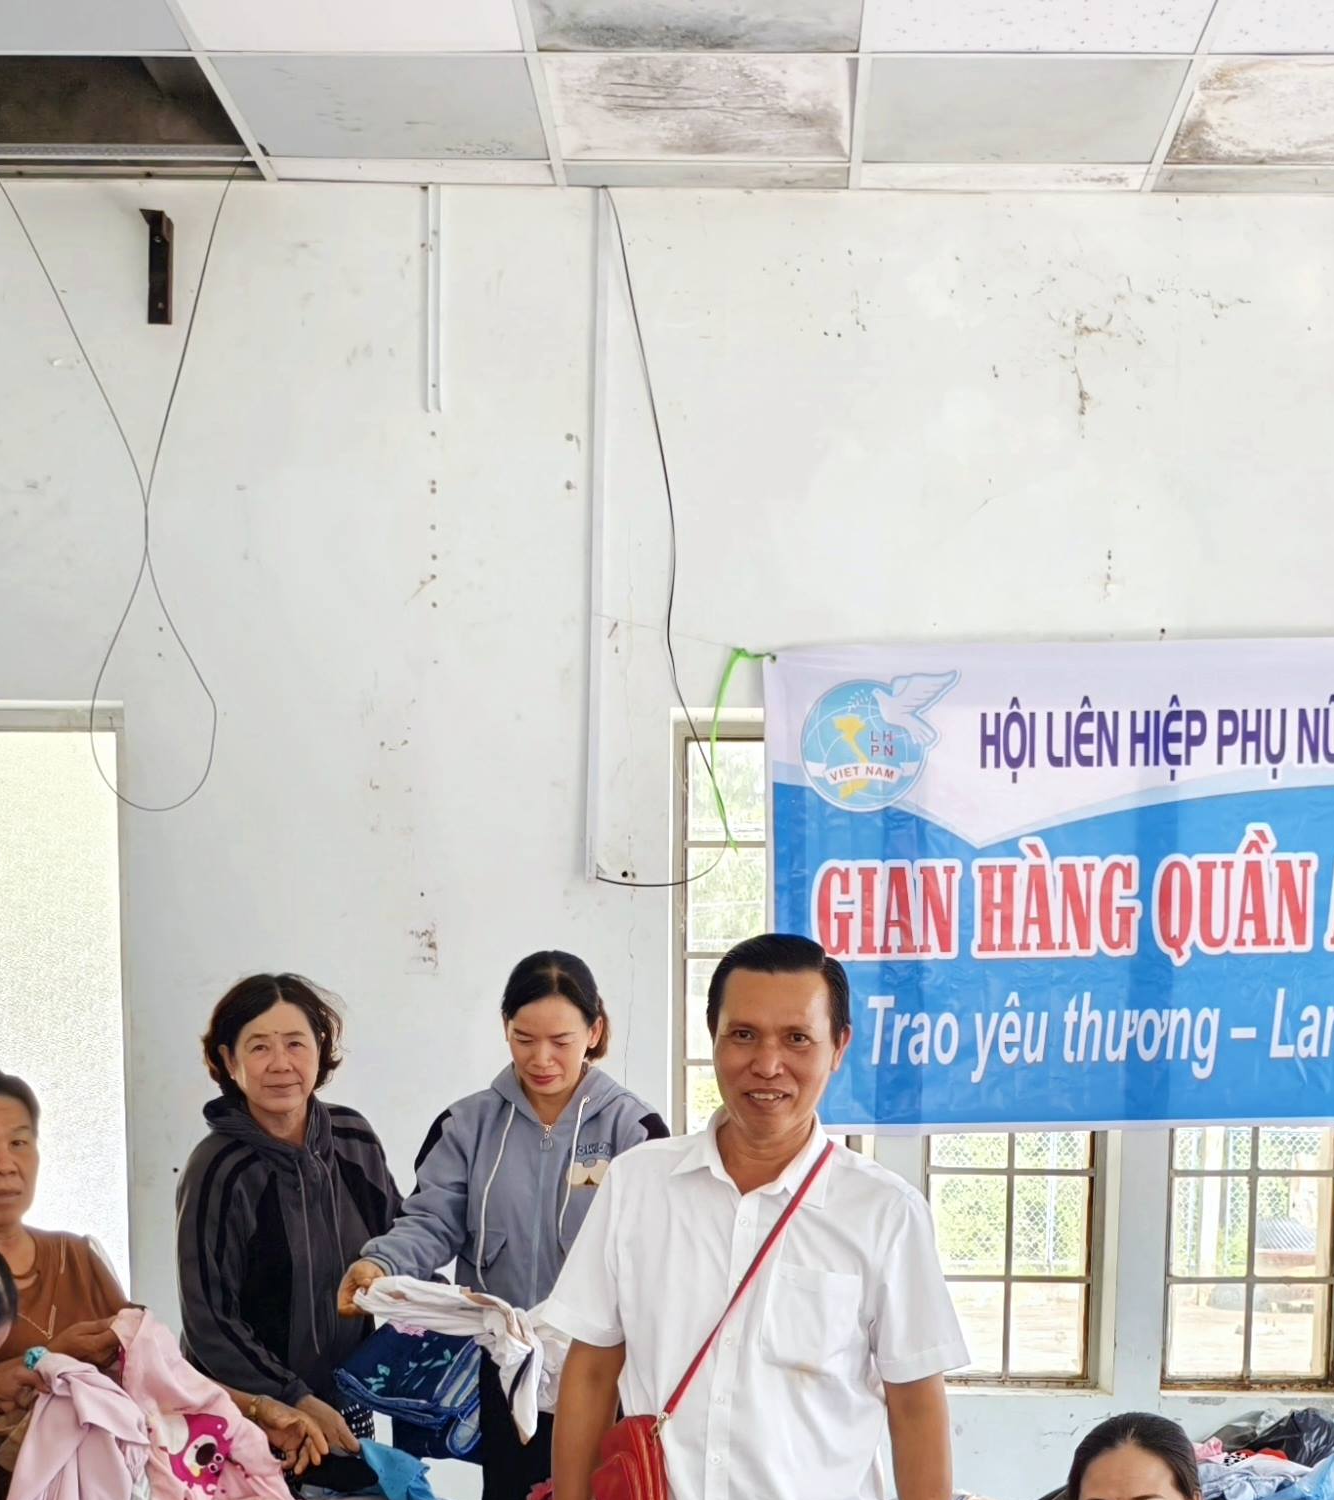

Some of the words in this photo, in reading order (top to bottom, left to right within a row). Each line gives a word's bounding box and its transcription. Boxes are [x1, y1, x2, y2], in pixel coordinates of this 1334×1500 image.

[864, 764, 896, 781] NAM
[979, 695, 1037, 785] HỘI
[1045, 694, 1120, 769] LIÊN
[1129, 693, 1209, 783] HIỆP
[1215, 707, 1289, 781] PHỤ
[814, 862, 959, 957] GIAN
[975, 842, 1138, 954] HÀNG
[1157, 828, 1314, 961] QUẦN
[866, 993, 961, 1066] Trao
[970, 990, 1051, 1084] yêu
[1062, 990, 1222, 1081] thương
